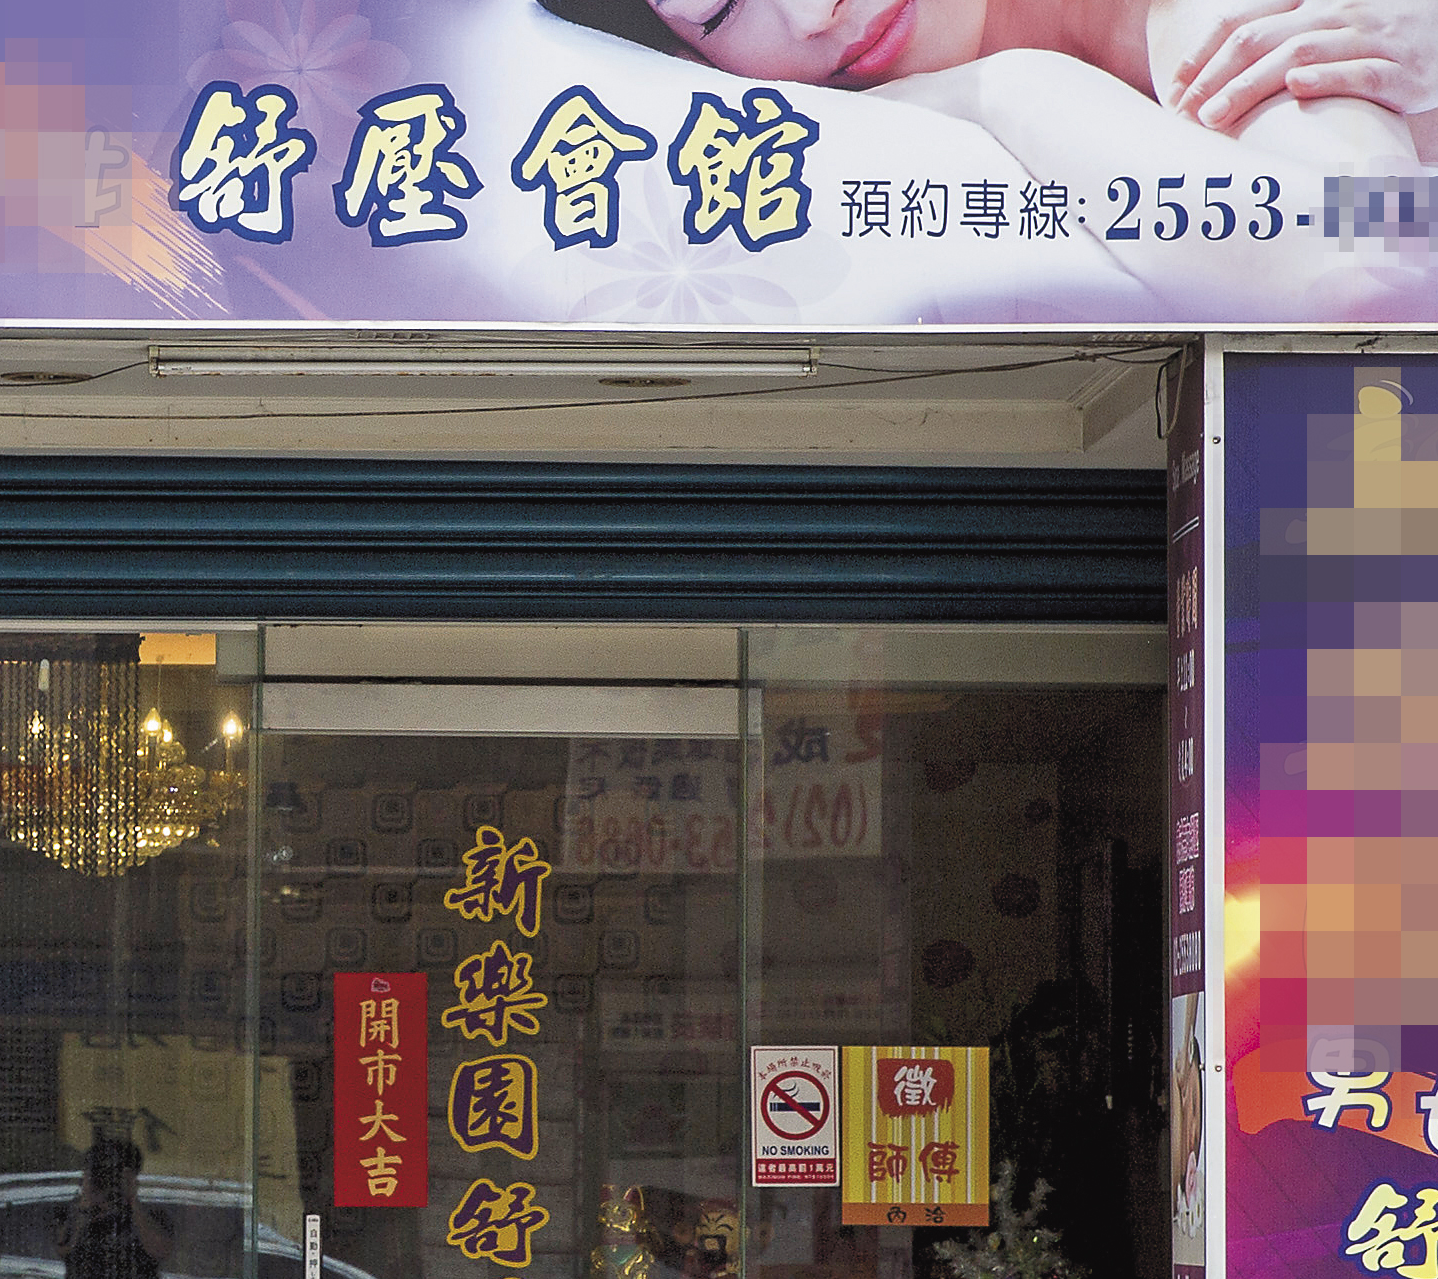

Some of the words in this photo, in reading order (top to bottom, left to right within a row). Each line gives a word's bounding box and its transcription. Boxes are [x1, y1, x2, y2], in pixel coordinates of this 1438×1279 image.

[170, 80, 820, 252] 舒壓會館
[839, 176, 1089, 242] 預約專線:
[358, 996, 408, 1199] 開市大吉
[893, 1064, 937, 1107] 徵
[762, 1145, 779, 1156] NO
[780, 1145, 830, 1156] SMOKING
[867, 1140, 961, 1184] 師傅
